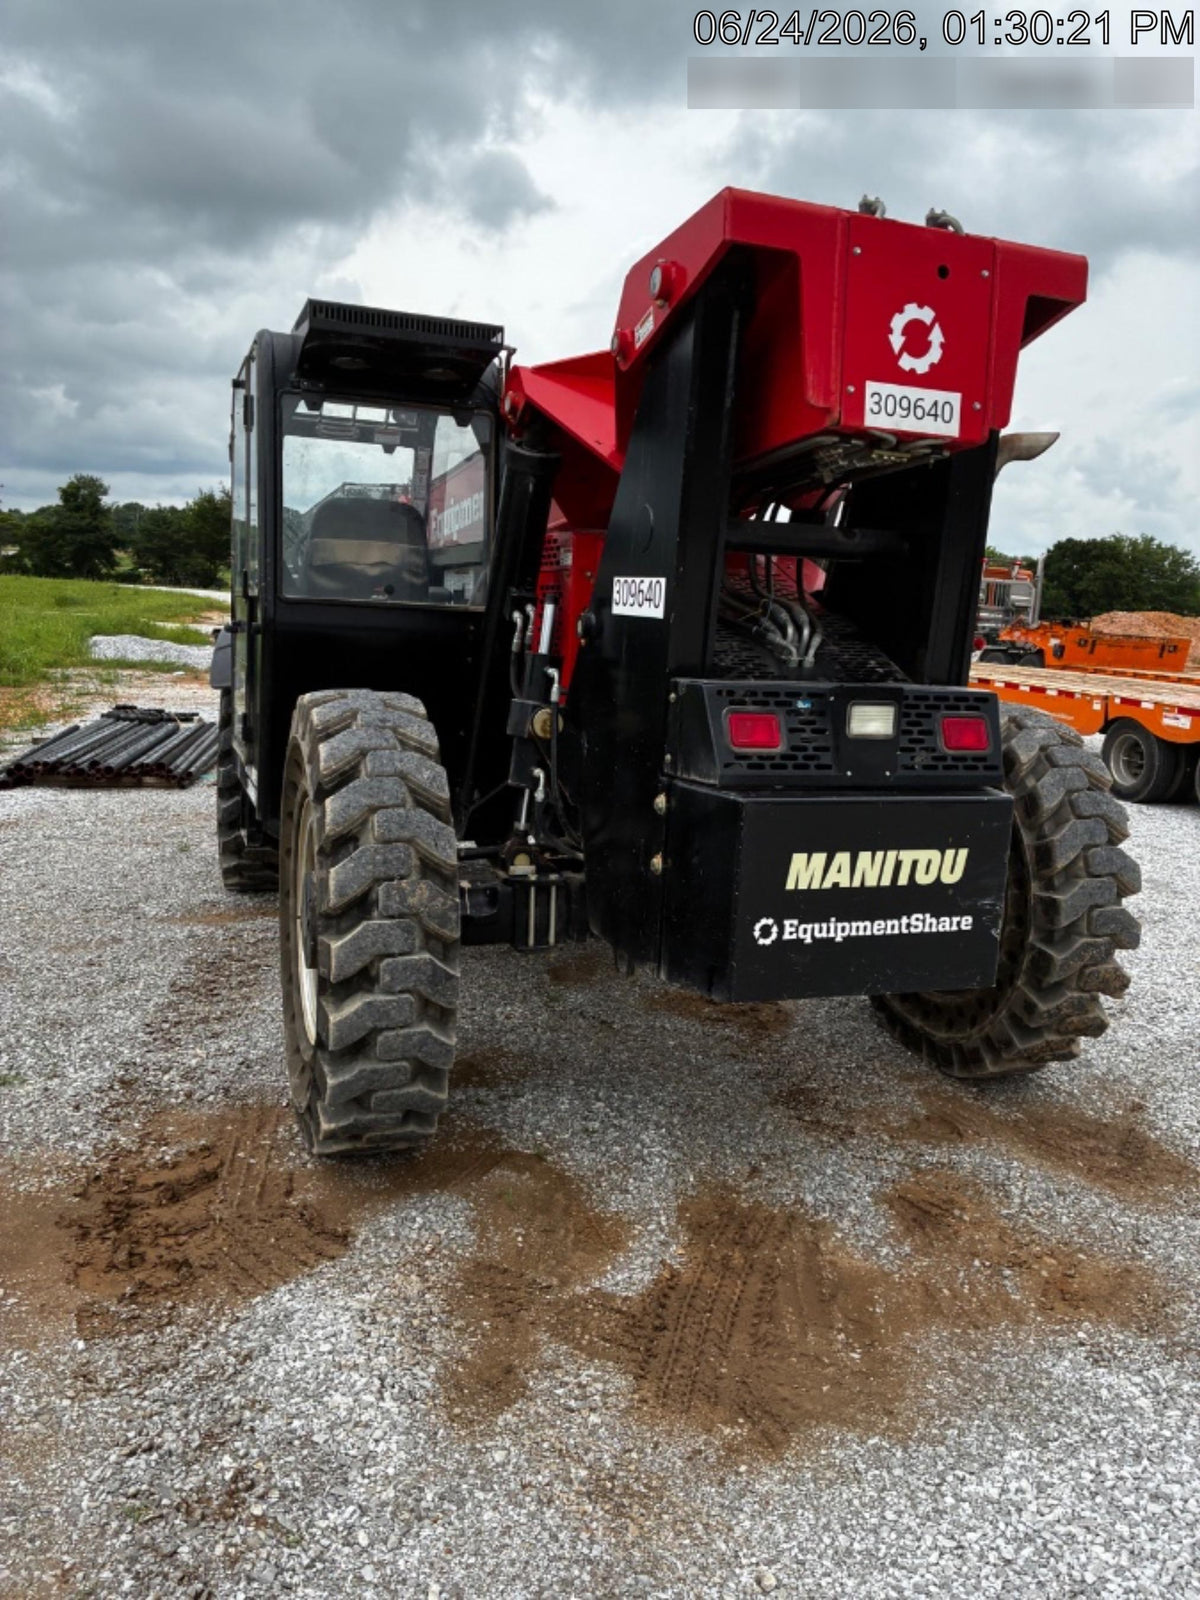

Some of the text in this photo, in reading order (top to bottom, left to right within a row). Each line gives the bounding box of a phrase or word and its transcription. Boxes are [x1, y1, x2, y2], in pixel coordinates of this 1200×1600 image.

[869, 391, 955, 424] 309640
[615, 579, 662, 609] 309640
[785, 848, 970, 890] MANITOU
[782, 912, 973, 944] EquipmentShare
